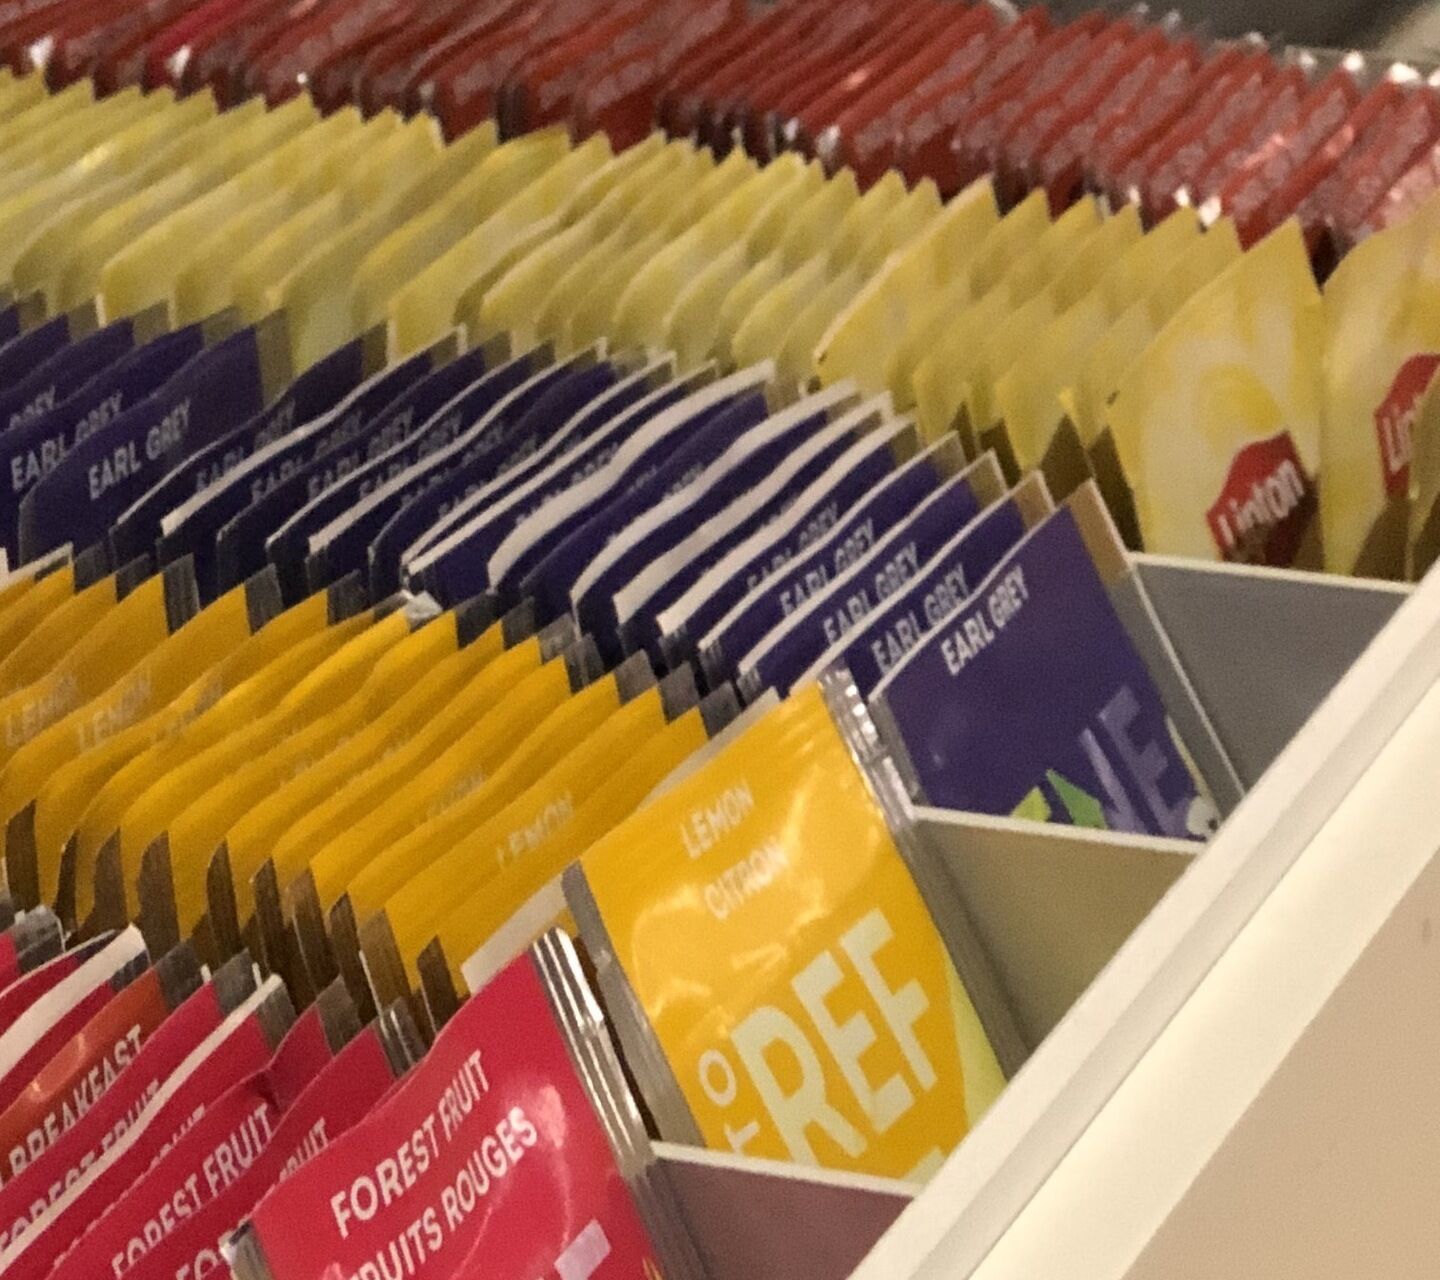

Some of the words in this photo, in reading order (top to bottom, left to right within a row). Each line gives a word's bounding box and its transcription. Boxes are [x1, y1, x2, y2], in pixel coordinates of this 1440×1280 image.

[11, 433, 70, 491] EARL
[88, 440, 141, 500] EARL
[146, 399, 191, 460] GREY
[871, 611, 922, 675] EARL
[924, 564, 969, 625] GREY
[941, 610, 995, 677] EARL
[987, 565, 1029, 629] GREY
[679, 779, 756, 859] LEMON
[703, 834, 787, 922] CITRON
[731, 907, 938, 1168] REF
[203, 1103, 274, 1199] FRUIT
[330, 1113, 439, 1240] FOREST
[438, 1049, 490, 1142] FRUIT
[440, 1106, 537, 1232] ROUGES
